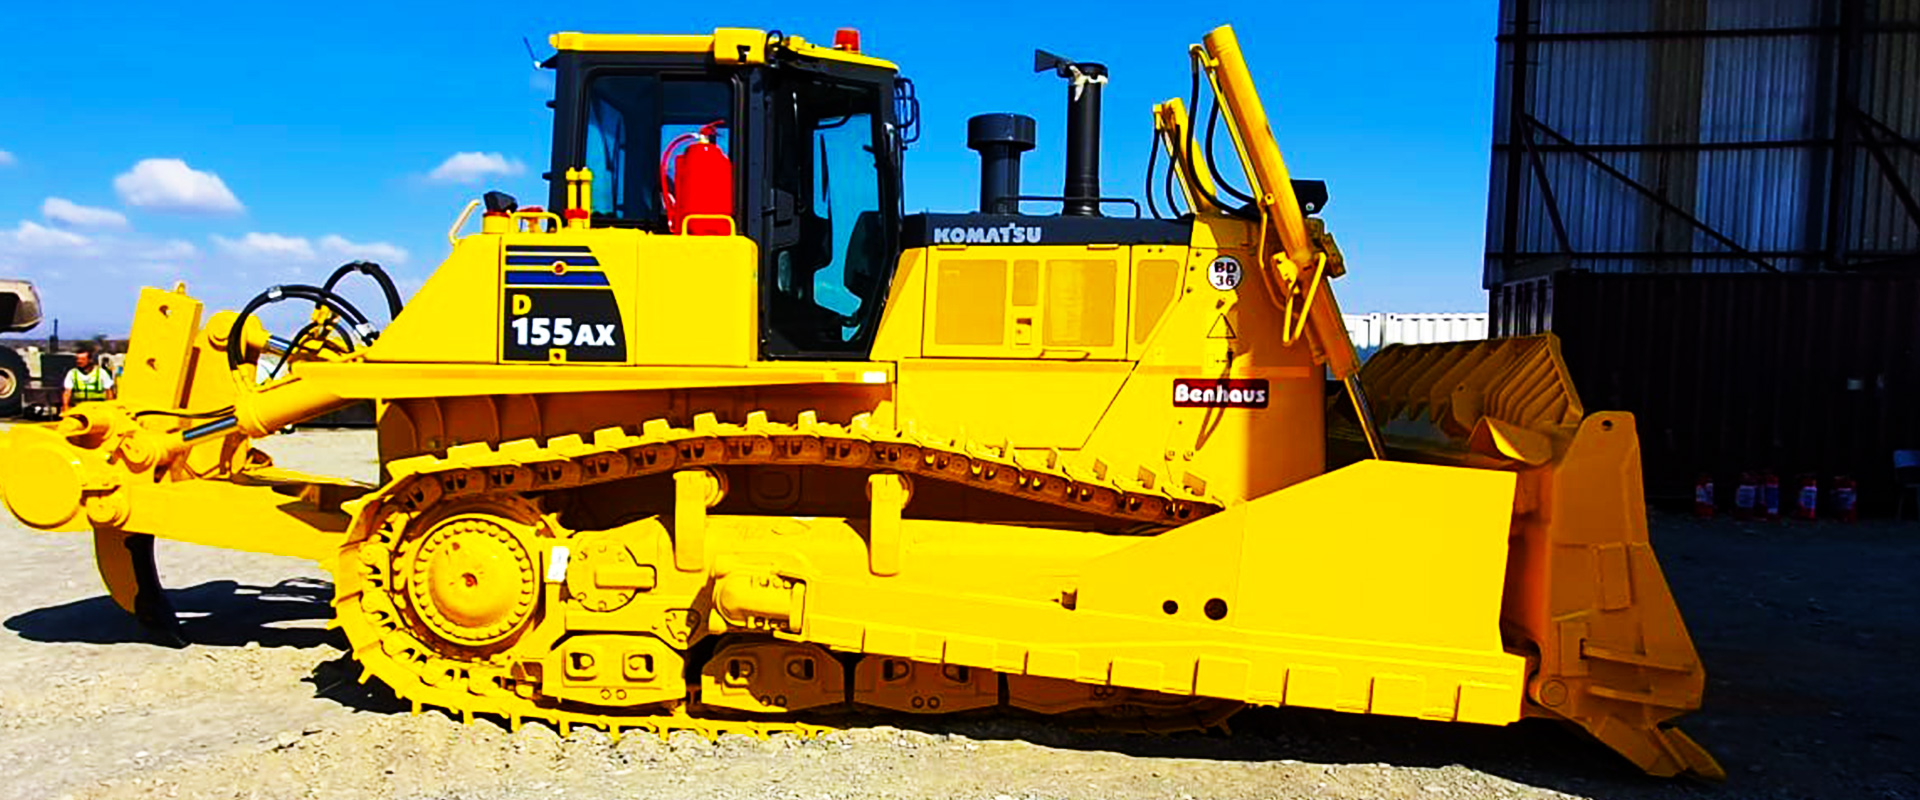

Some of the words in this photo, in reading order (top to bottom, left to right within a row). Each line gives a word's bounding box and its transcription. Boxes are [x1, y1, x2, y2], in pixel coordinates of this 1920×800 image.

[933, 222, 1042, 243] KOMATSU
[1214, 262, 1237, 274] BD
[1215, 275, 1235, 286] 36
[511, 294, 532, 316] D
[511, 317, 616, 346] 155AX
[1174, 383, 1266, 403] Benhaus
